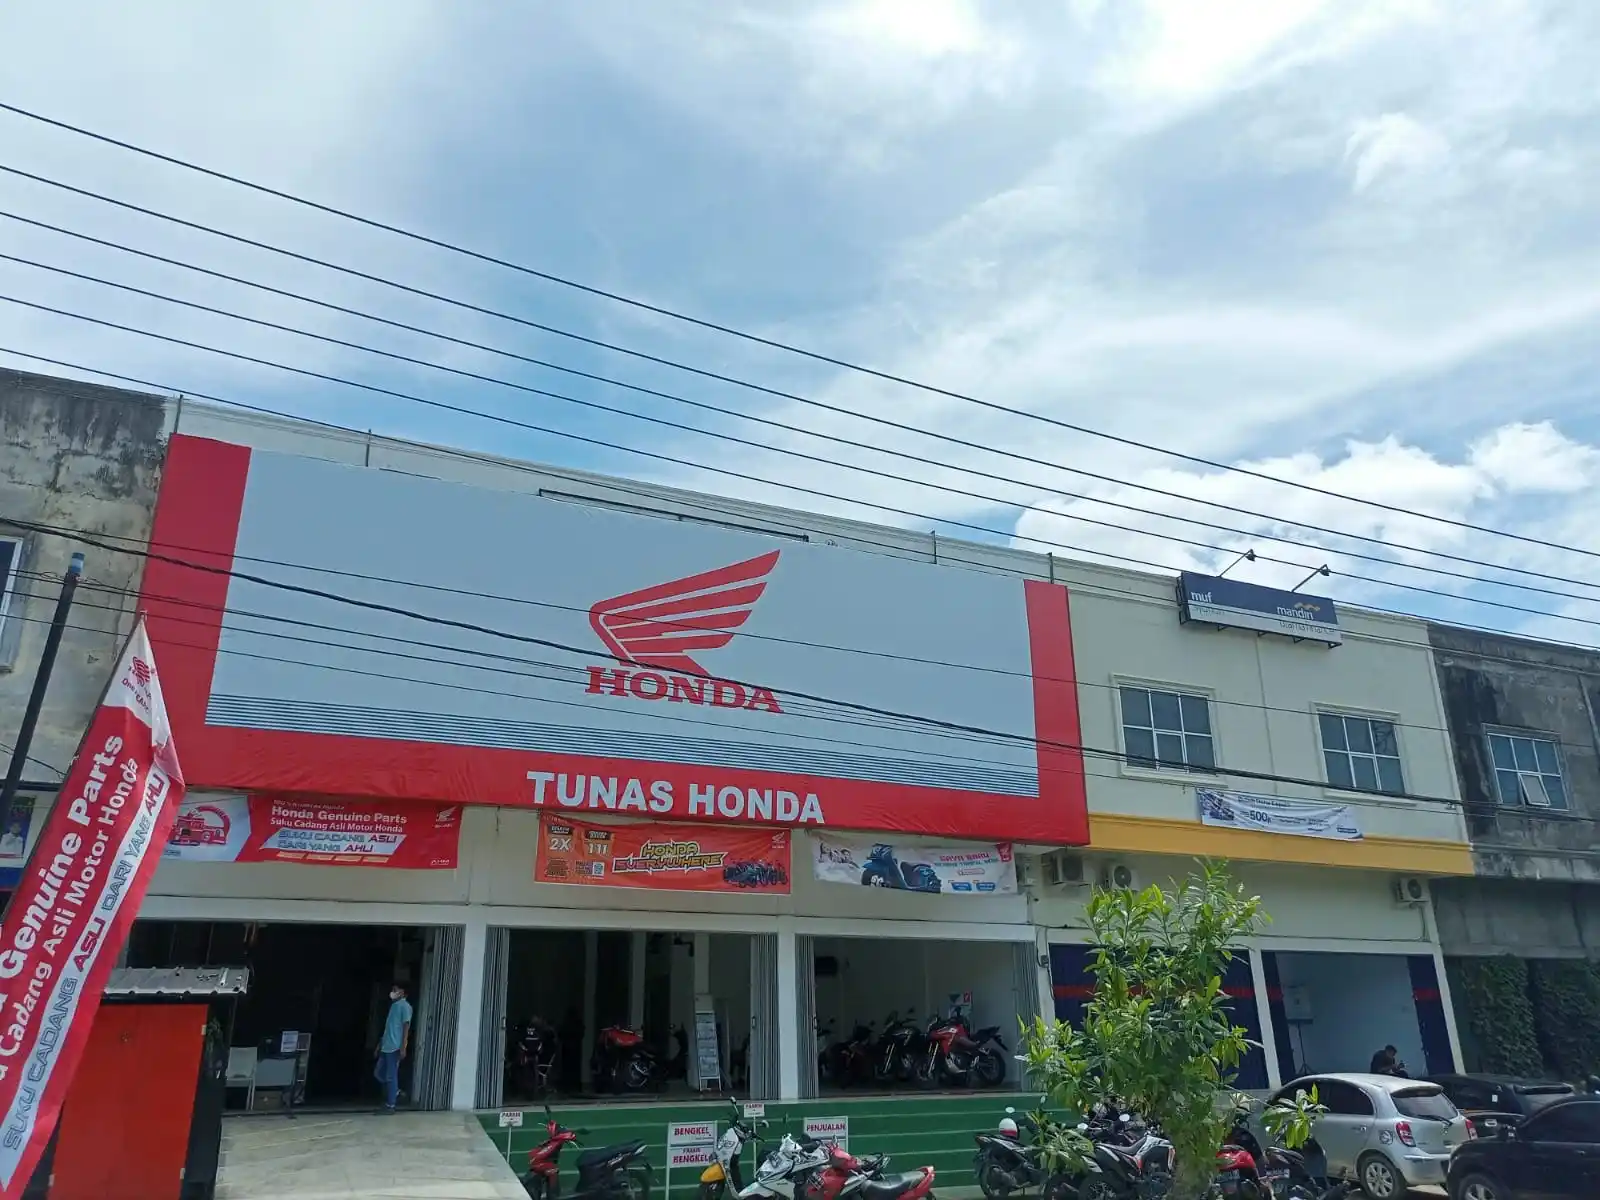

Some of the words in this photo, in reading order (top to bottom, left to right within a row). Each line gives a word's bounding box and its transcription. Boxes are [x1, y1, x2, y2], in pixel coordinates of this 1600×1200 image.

[1191, 591, 1212, 603] muf
[585, 666, 785, 714] HONDA
[526, 770, 674, 813] TUNAS
[688, 783, 825, 824] HONDA
[272, 806, 313, 819] Honda
[318, 810, 371, 822] Genuine
[374, 813, 408, 824] Parts
[270, 817, 293, 827] Suku
[294, 820, 328, 831] Cadang
[330, 822, 346, 831] Asli
[347, 823, 374, 832] Motor
[375, 824, 403, 833] Honda
[314, 833, 364, 843] CADANG
[368, 834, 398, 844] ASLI
[344, 844, 374, 853] AHLI
[642, 843, 698, 857] HONDA
[0, 832, 83, 979] Genuine
[67, 735, 124, 827] Parts
[615, 853, 723, 871] EVERYWHERE
[0, 961, 53, 1057] Cadang
[42, 907, 77, 957] Asli
[64, 829, 110, 906] Motor
[98, 758, 140, 826] Honda
[4, 1086, 37, 1150] SUKU
[28, 977, 78, 1082] CADANG
[73, 916, 107, 973] ASLI
[101, 859, 134, 911] DARI
[145, 772, 166, 817] AHLI
[674, 1126, 710, 1136] BENGKEL
[806, 1123, 846, 1132] PENJUALAN
[672, 1154, 710, 1164] BENGKEL
